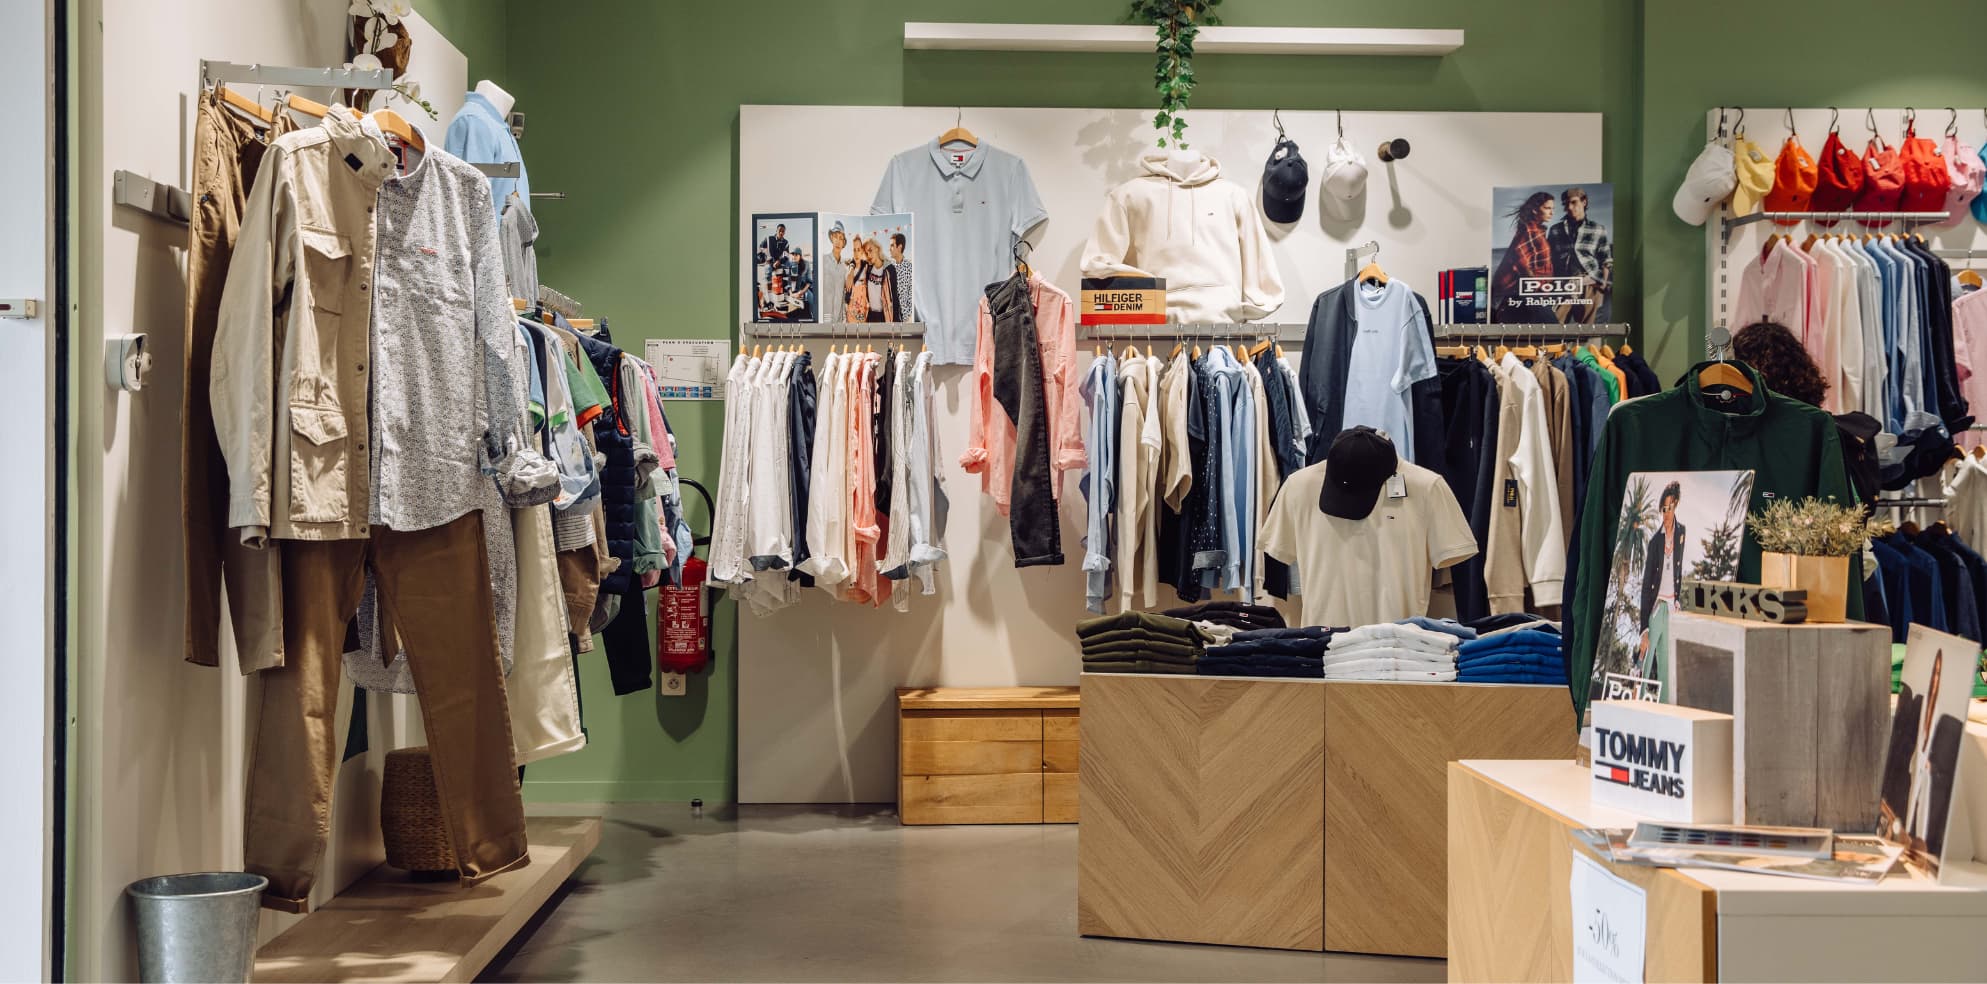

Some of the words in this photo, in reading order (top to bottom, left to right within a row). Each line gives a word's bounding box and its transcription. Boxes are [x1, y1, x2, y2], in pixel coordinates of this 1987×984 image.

[1524, 281, 1576, 292] Polo
[1094, 293, 1143, 302] HILFIGER
[1508, 297, 1522, 308] by
[1526, 297, 1556, 307] Ralph
[1558, 297, 1593, 305] Lauren
[1113, 303, 1143, 311] DENIM
[1687, 581, 1785, 624] IKKS
[1607, 680, 1658, 703] Polo
[1595, 727, 1685, 774] TOMMY
[1630, 768, 1684, 799] JEANS
